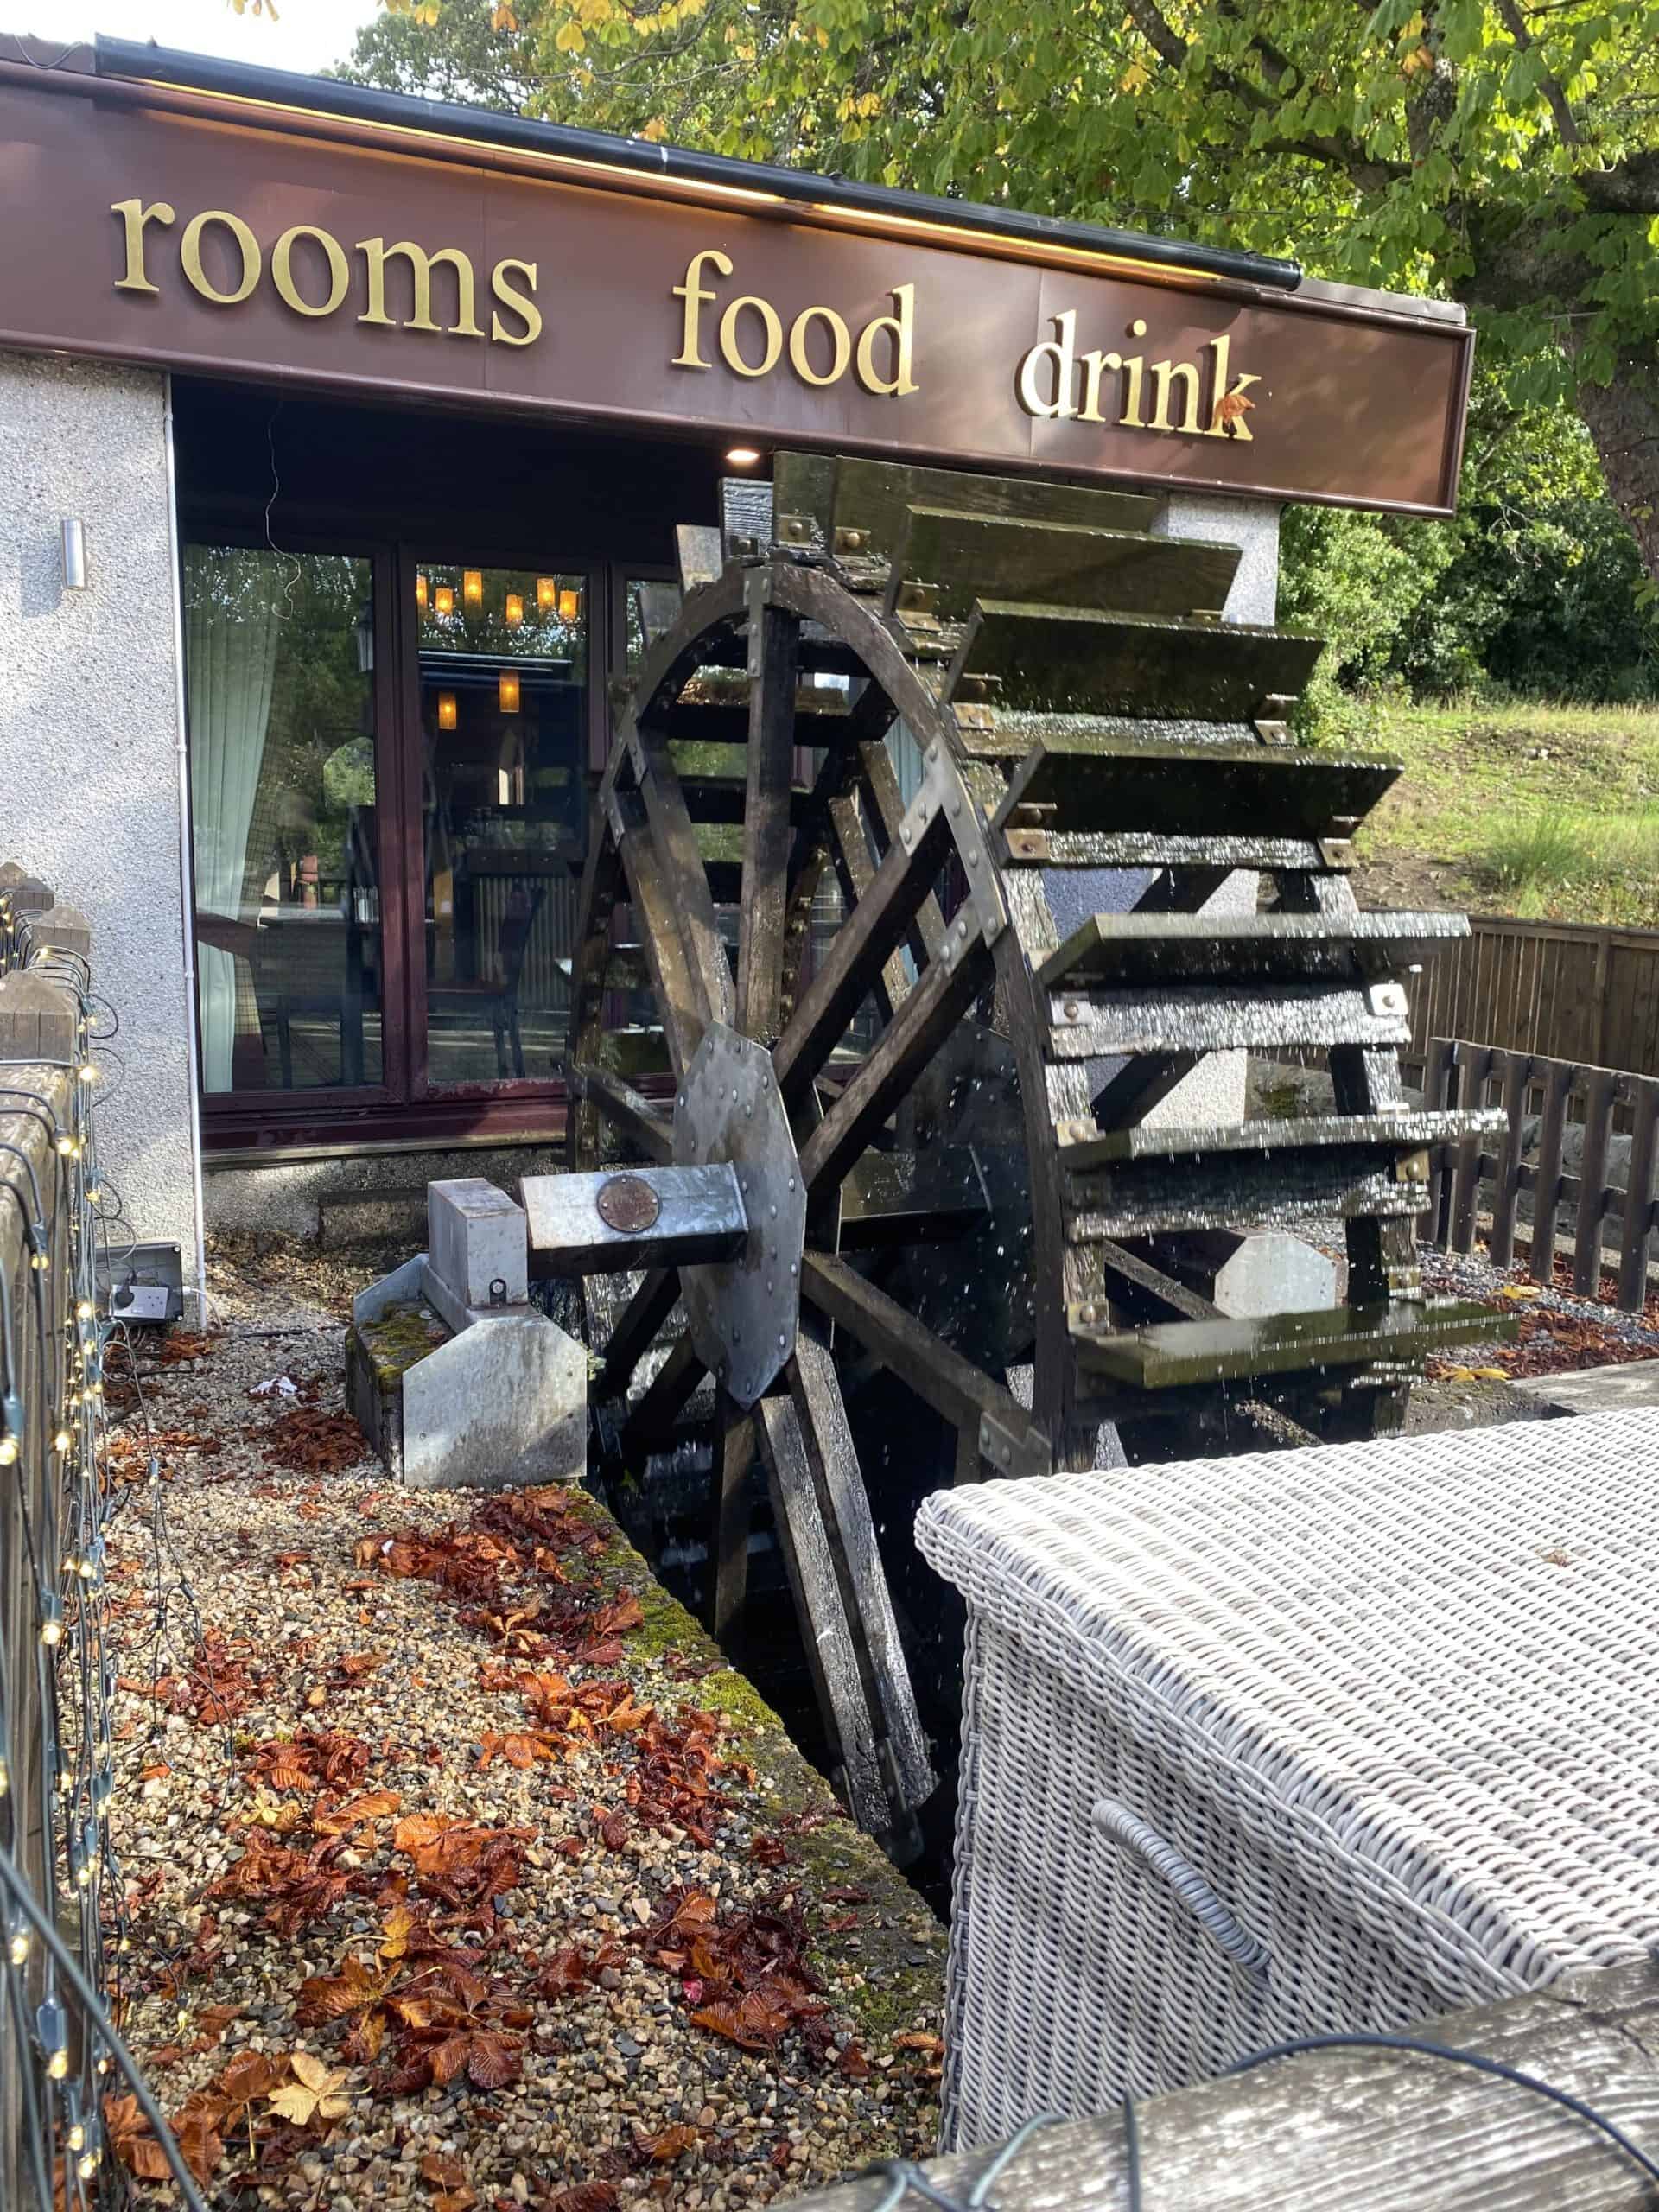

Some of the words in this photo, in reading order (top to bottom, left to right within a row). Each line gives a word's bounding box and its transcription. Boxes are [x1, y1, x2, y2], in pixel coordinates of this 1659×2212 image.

[111, 198, 543, 346] rooms
[671, 250, 920, 397] food
[1020, 308, 1262, 442] drink
